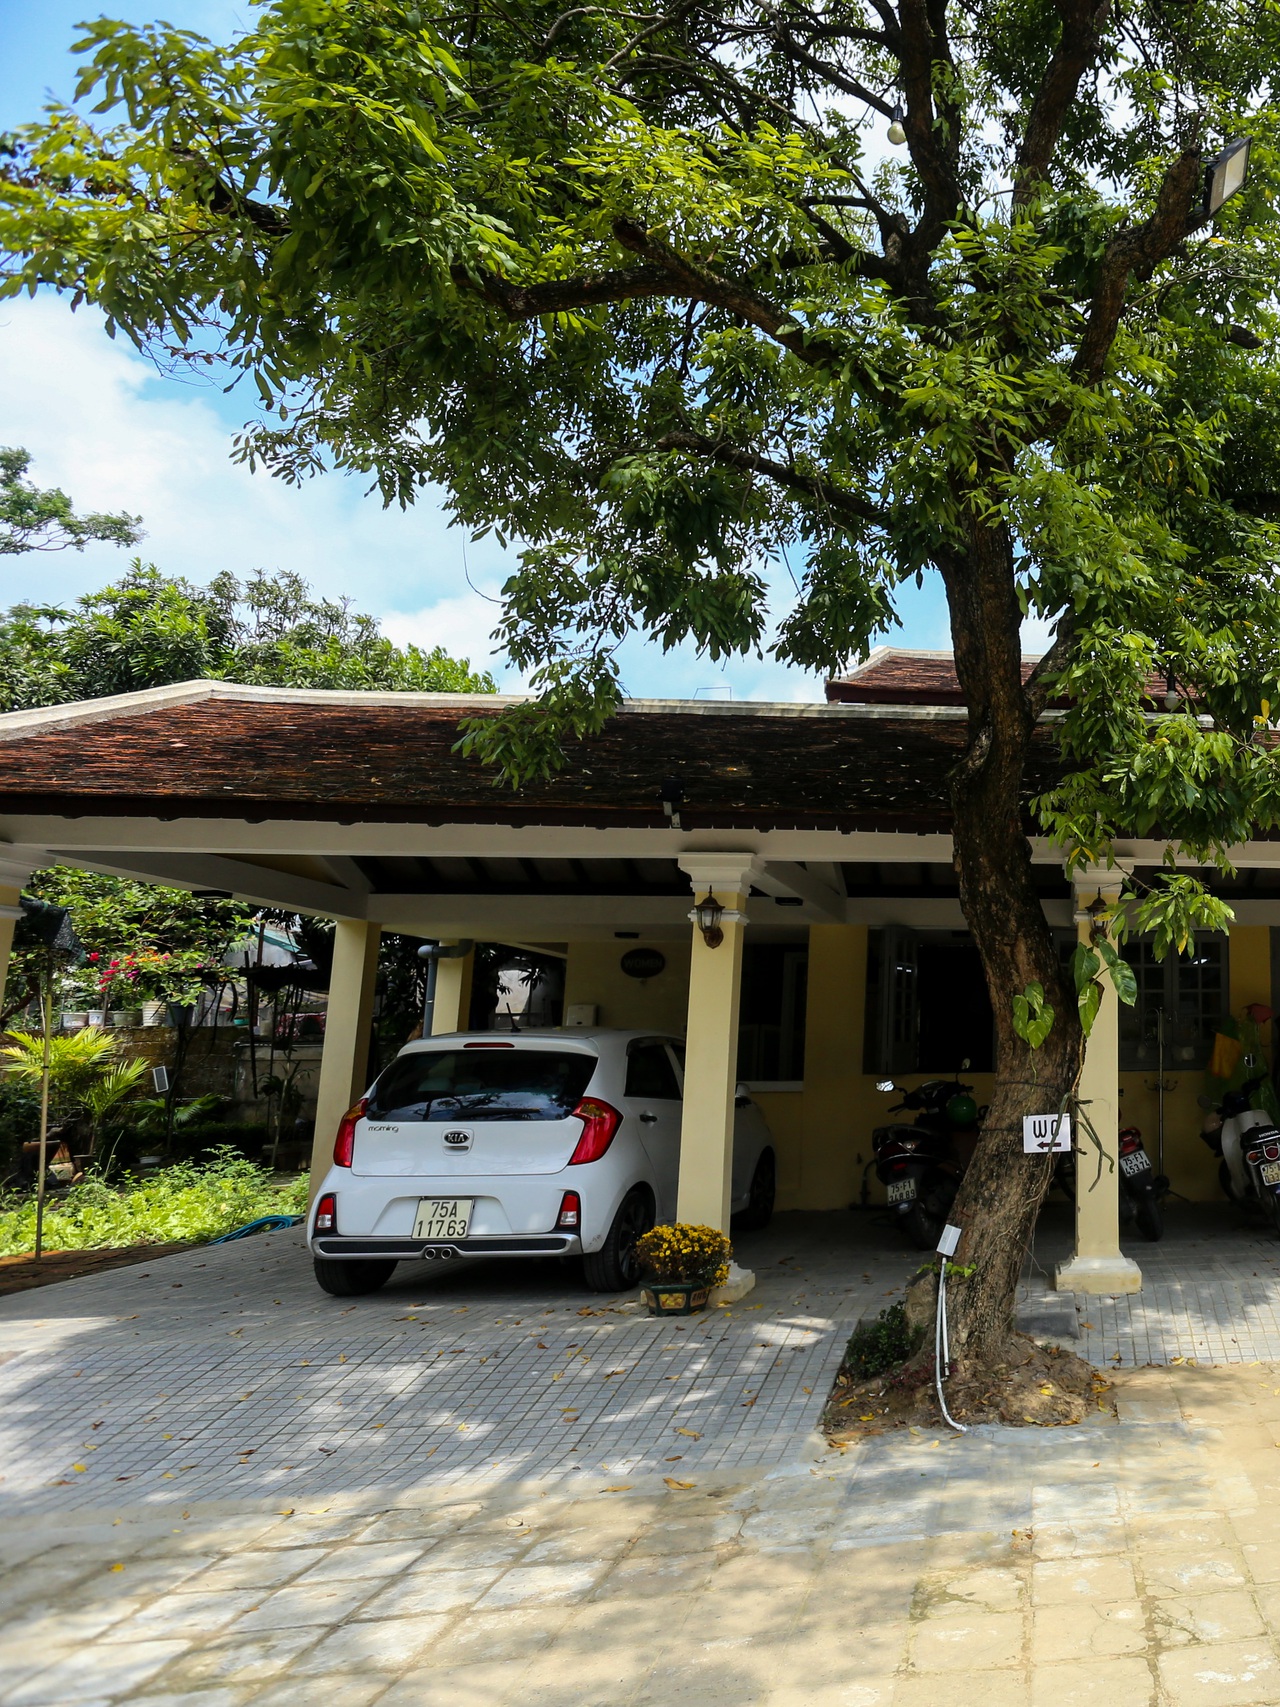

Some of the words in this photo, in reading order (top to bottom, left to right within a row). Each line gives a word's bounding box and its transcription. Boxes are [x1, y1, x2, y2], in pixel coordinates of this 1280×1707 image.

[624, 958, 662, 969] WOMEN
[447, 1133, 465, 1142] KIA
[1258, 1129, 1280, 1138] HONDA
[431, 1201, 458, 1218] 75A
[417, 1219, 467, 1237] 117.63
